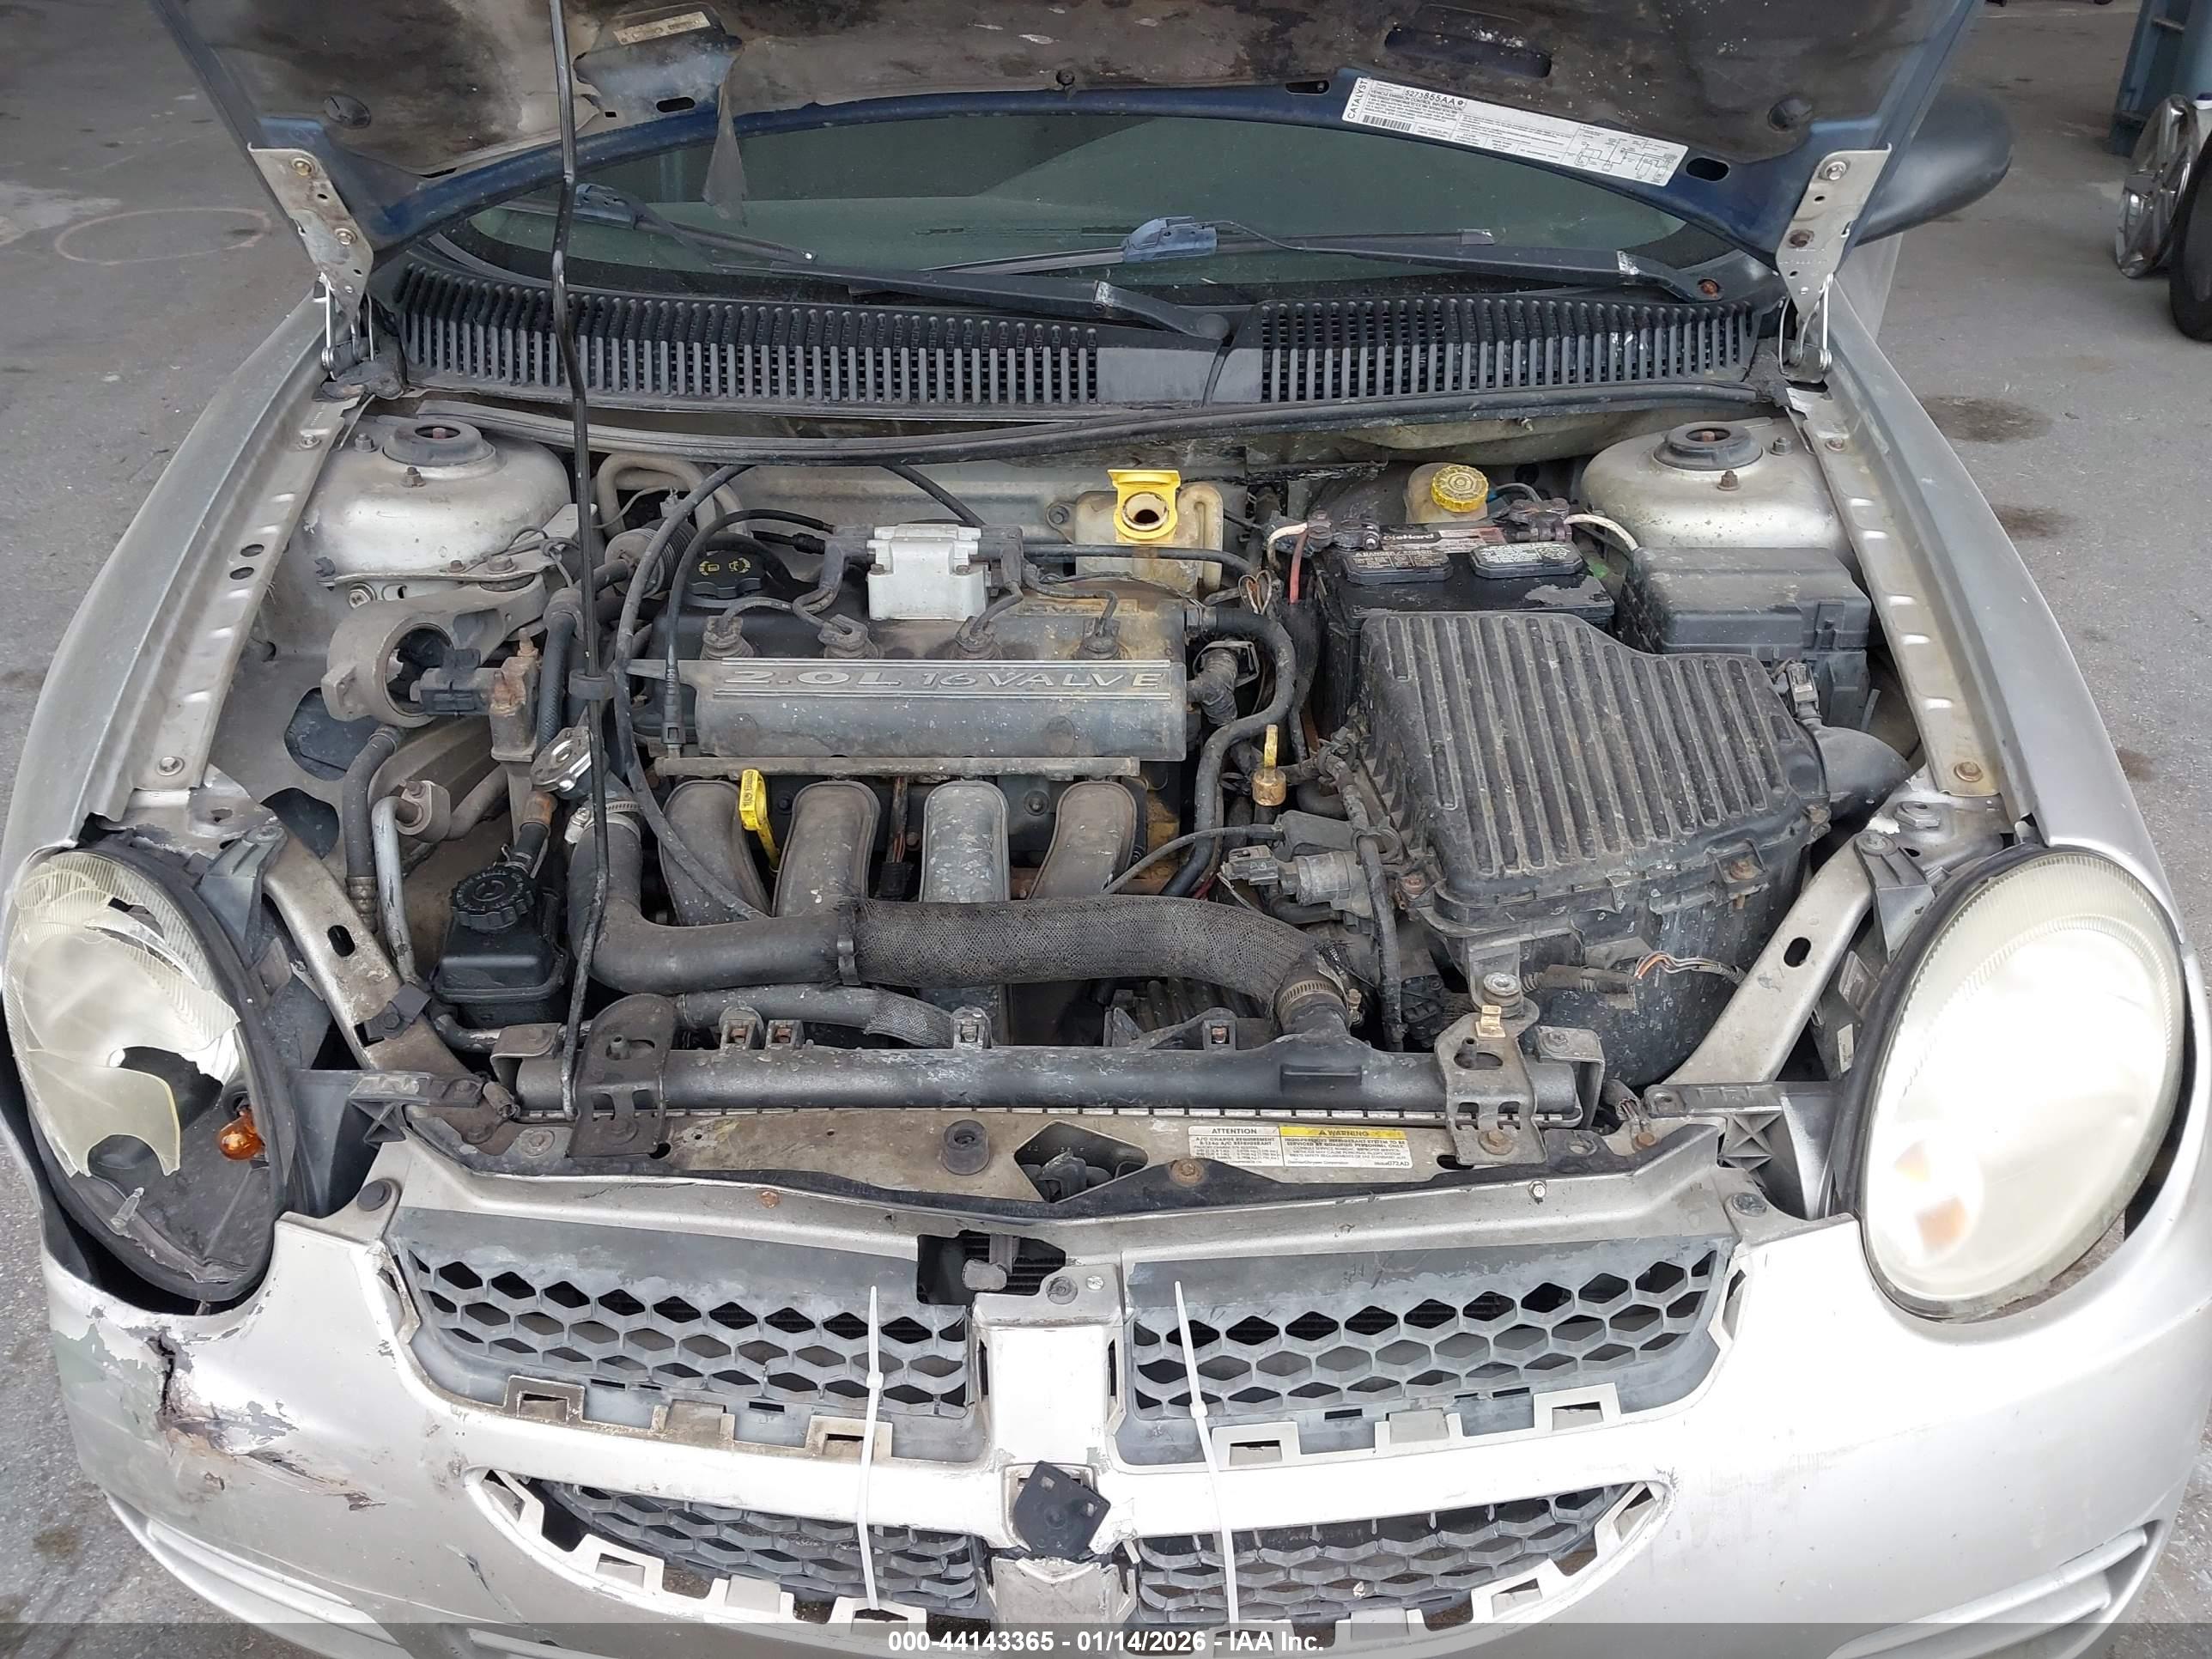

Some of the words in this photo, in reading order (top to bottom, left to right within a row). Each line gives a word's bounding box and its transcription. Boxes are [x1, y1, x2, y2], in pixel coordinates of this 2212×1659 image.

[1347, 80, 1368, 119] CATALYST
[1405, 89, 1456, 106] 5273855AA
[725, 672, 901, 686] 2.0L
[921, 672, 977, 686] 16
[988, 672, 1167, 688] VALVE
